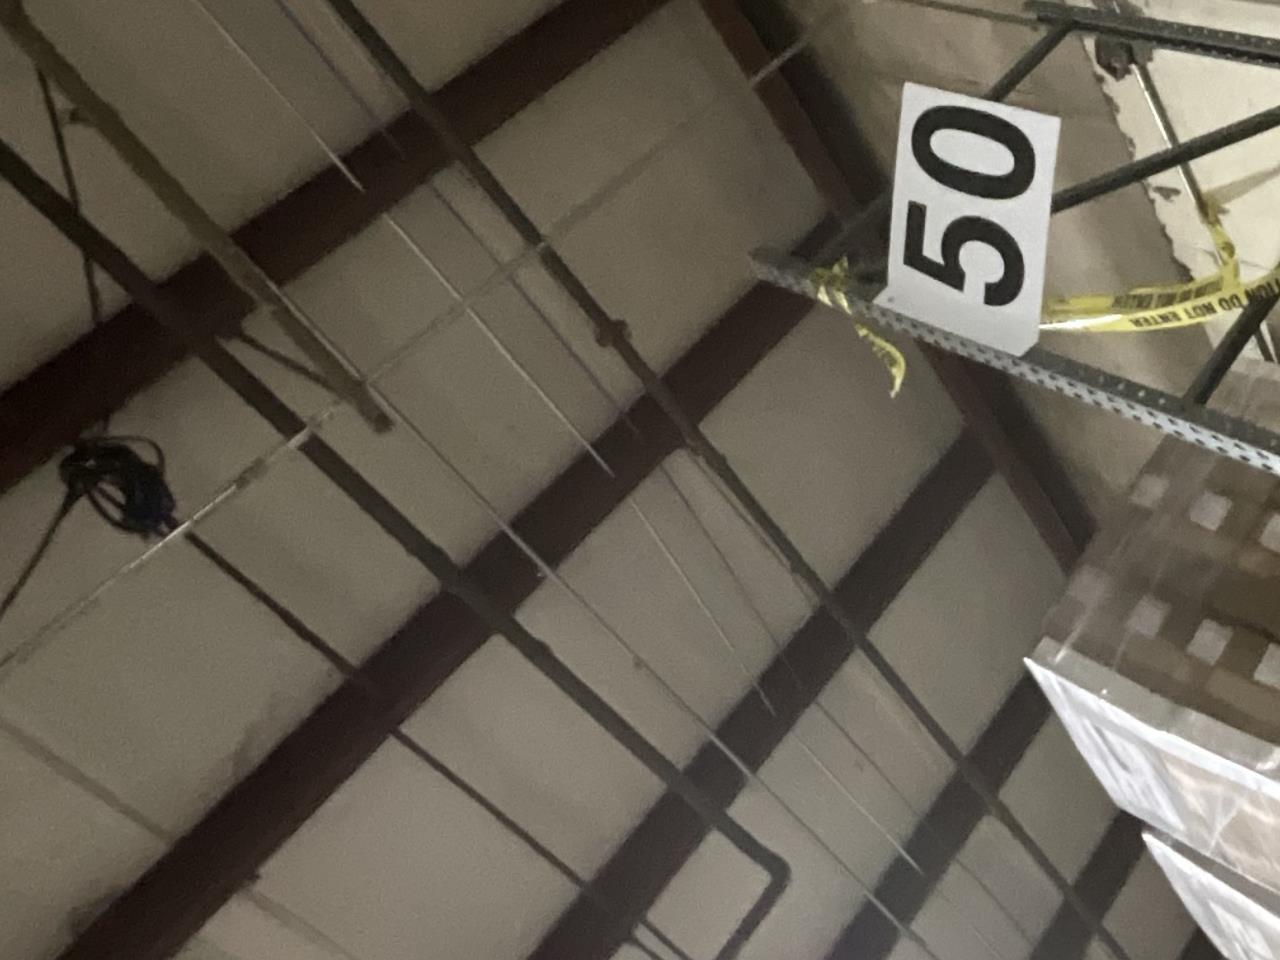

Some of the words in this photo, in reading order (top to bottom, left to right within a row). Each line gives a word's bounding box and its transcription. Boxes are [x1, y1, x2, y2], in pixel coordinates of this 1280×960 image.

[904, 106, 1036, 307] 50
[1183, 301, 1217, 319] NOT
[1218, 293, 1246, 311] DO
[1129, 311, 1182, 328] ENTER
